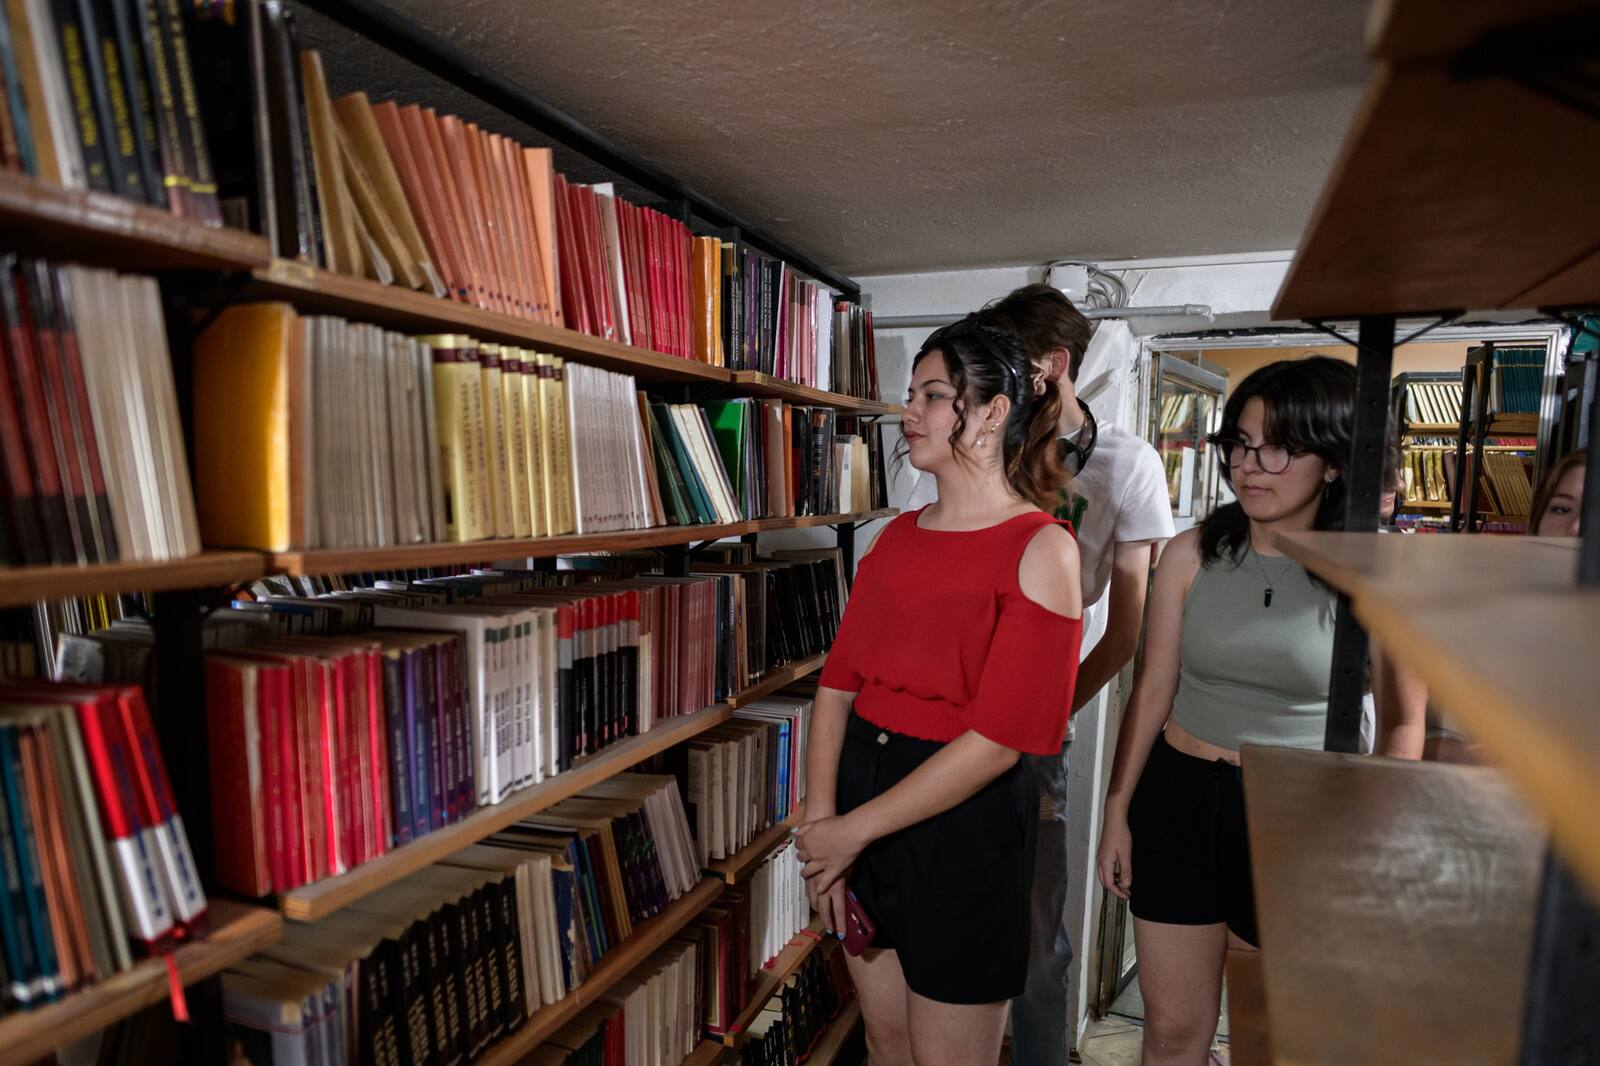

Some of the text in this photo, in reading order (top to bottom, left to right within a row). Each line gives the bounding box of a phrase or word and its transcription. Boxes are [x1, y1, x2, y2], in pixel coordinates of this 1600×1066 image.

[464, 964, 477, 1029] FAUSTI
[476, 957, 488, 1021] FAUSTI
[488, 948, 502, 1010] FAUSTI
[506, 941, 518, 1002] FAUSTI
[433, 983, 448, 1051] FAUSTI
[446, 973, 460, 1039] FAUSTI
